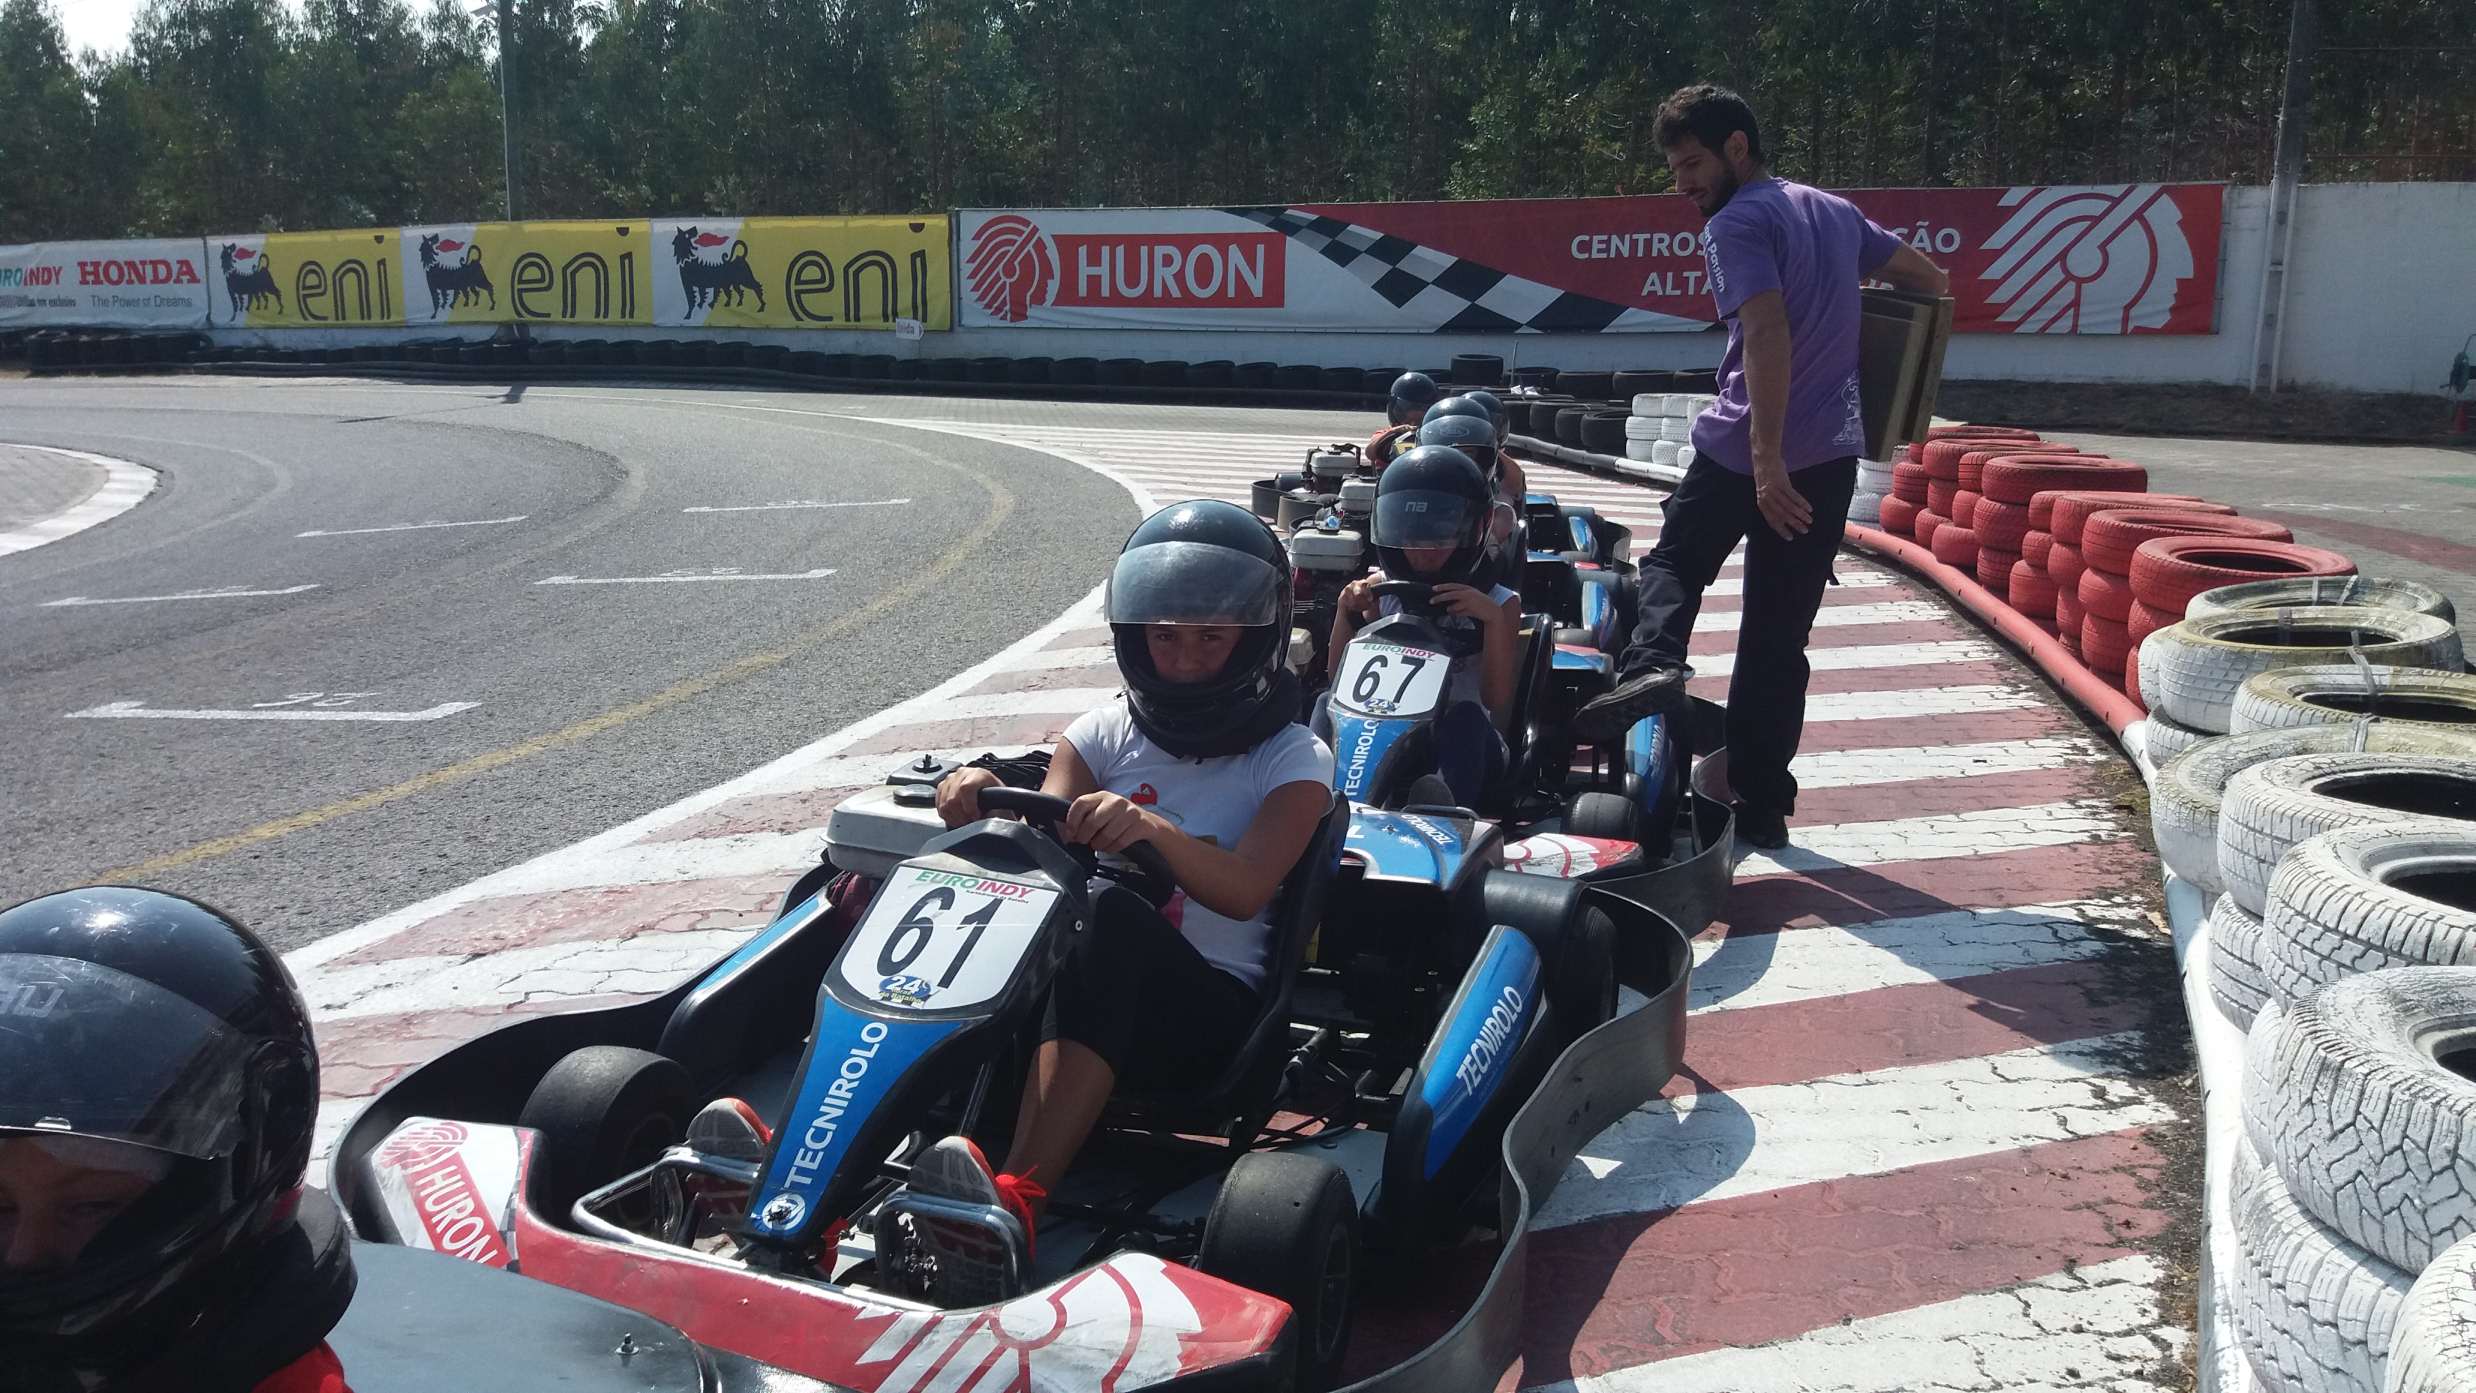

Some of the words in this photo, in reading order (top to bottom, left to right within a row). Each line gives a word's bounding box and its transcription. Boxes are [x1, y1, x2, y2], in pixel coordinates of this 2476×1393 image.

[1889, 221, 1961, 253] ÃO
[0, 266, 63, 287] ROINDY
[77, 259, 200, 286] HONDA
[296, 235, 391, 321] eni
[511, 227, 635, 319] eni
[785, 222, 928, 323] eni
[1078, 243, 1265, 298] HURON
[91, 295, 111, 308] The
[112, 295, 140, 308] Power
[154, 295, 193, 308] Dreams
[1352, 654, 1426, 704] 67
[1363, 643, 1437, 660] EUROINDY
[1344, 719, 1380, 796] TECNIROLO
[915, 870, 1035, 899] EUROINDY
[876, 886, 1004, 989] 61
[886, 975, 922, 994] 24
[1456, 986, 1523, 1097] TECNIROLO
[784, 1022, 888, 1190] TECNIROLO
[415, 1165, 498, 1264] HURON
